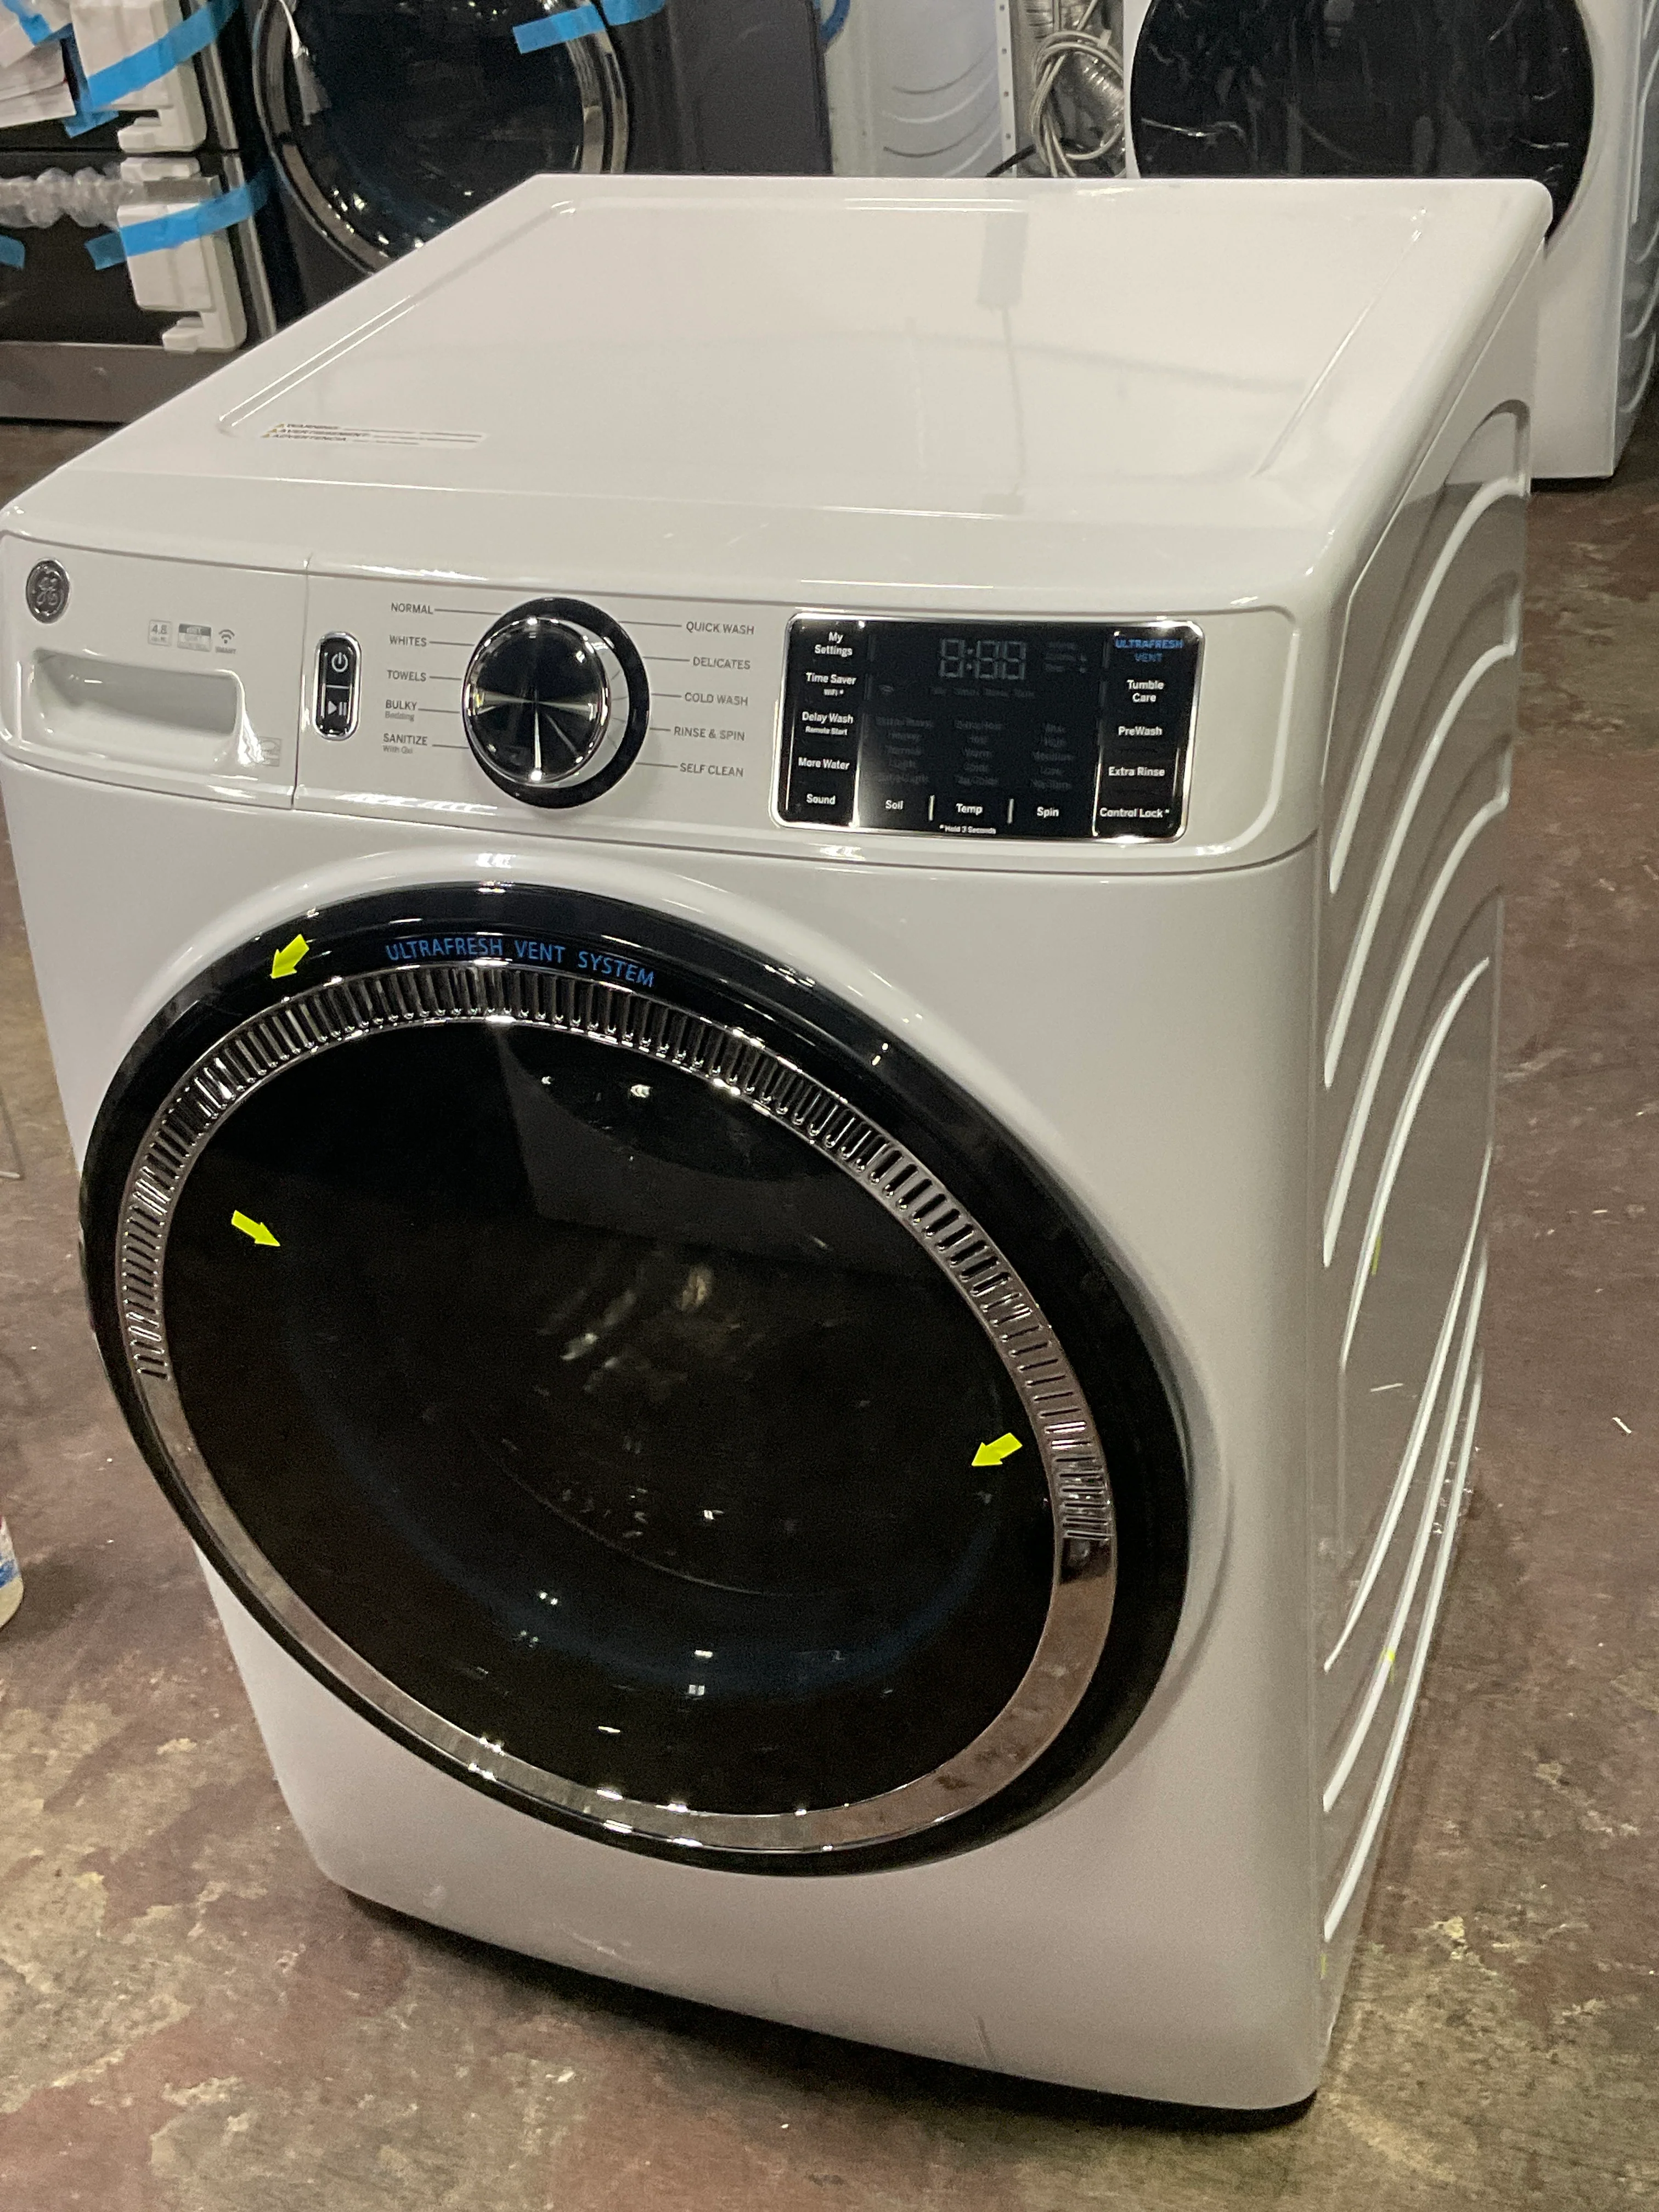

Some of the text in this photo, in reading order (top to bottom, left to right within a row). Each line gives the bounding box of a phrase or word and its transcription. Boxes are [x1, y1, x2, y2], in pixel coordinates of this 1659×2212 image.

[391, 602, 433, 615] NORMAL
[686, 621, 755, 635] QUICK WASH
[389, 634, 427, 647] WHITES
[828, 631, 844, 644] My
[1115, 639, 1184, 649] ULTRAFRESH
[814, 644, 853, 658] Settings
[1134, 653, 1163, 662] VENT
[693, 656, 752, 670] DELICATES
[386, 669, 427, 682] TOWELS
[805, 672, 857, 685] Time Saver
[1127, 679, 1165, 690] Tumble
[685, 692, 748, 707] COLD WASH
[1132, 692, 1157, 703] Care
[385, 699, 417, 711] BULKY
[802, 711, 854, 724] Delay Wash
[674, 726, 745, 741] RINSE & SPIN
[1118, 726, 1164, 736] PreWash
[383, 733, 428, 746] SANITIZE
[680, 763, 744, 777] SELF CLEAN
[798, 757, 850, 770] More Water
[1108, 766, 1165, 777] Extra Rinse
[806, 793, 836, 805] Sound
[885, 799, 904, 810] Soil
[956, 803, 983, 816] Temp
[1036, 806, 1059, 818] Spin
[1099, 807, 1163, 818] Control Lock
[386, 938, 654, 988] ULTRAFRESH VENT SYSTEM
